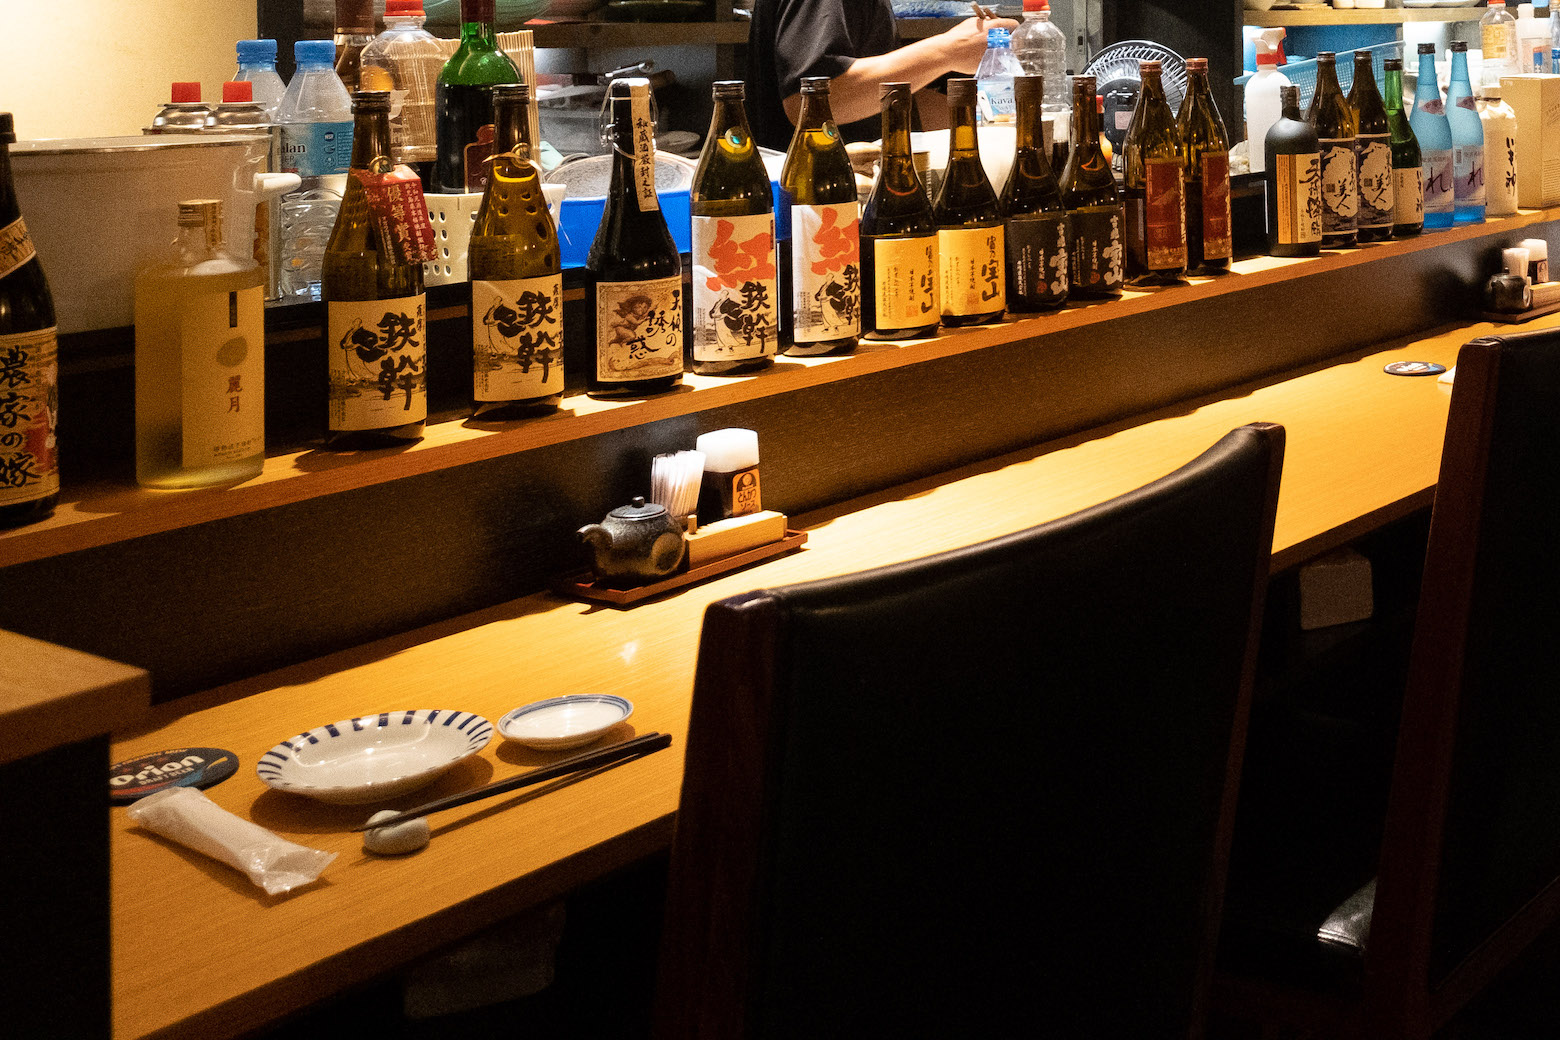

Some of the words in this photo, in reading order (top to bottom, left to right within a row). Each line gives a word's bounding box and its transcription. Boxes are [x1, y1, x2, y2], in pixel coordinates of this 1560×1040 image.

[990, 96, 1013, 105] Kava
[705, 218, 776, 293] 紅
[376, 311, 420, 411] 鉄幹
[516, 290, 557, 384] 鉄幹
[226, 374, 243, 414] 麗月
[109, 755, 205, 786] Orion
